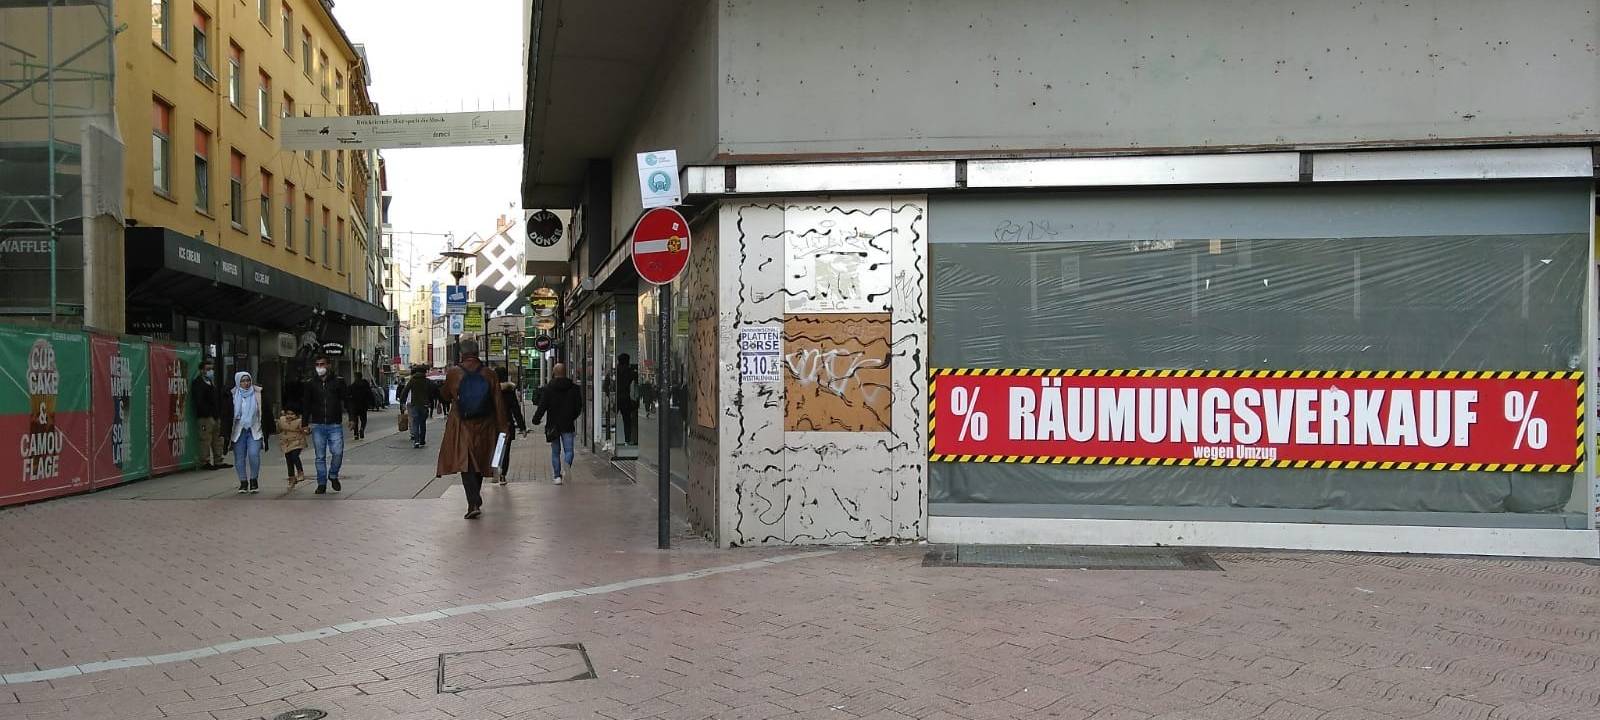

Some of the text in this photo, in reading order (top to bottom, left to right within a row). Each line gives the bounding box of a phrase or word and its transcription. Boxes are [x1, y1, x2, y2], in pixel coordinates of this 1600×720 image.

[529, 228, 562, 246] DÖNER
[178, 246, 201, 264] ICE CREAM
[742, 332, 779, 341] PLATTEN
[742, 340, 779, 350] BÖRSE
[31, 347, 56, 371] CUP
[742, 356, 770, 375] 3.10.
[29, 371, 59, 396] CAKE
[38, 402, 48, 425] &
[951, 377, 1548, 450] % RÄUMUNGSVERKAUF %
[20, 431, 63, 458] CAMOU
[1193, 445, 1277, 461] wegen Umzug
[22, 455, 59, 482] FLAGE
